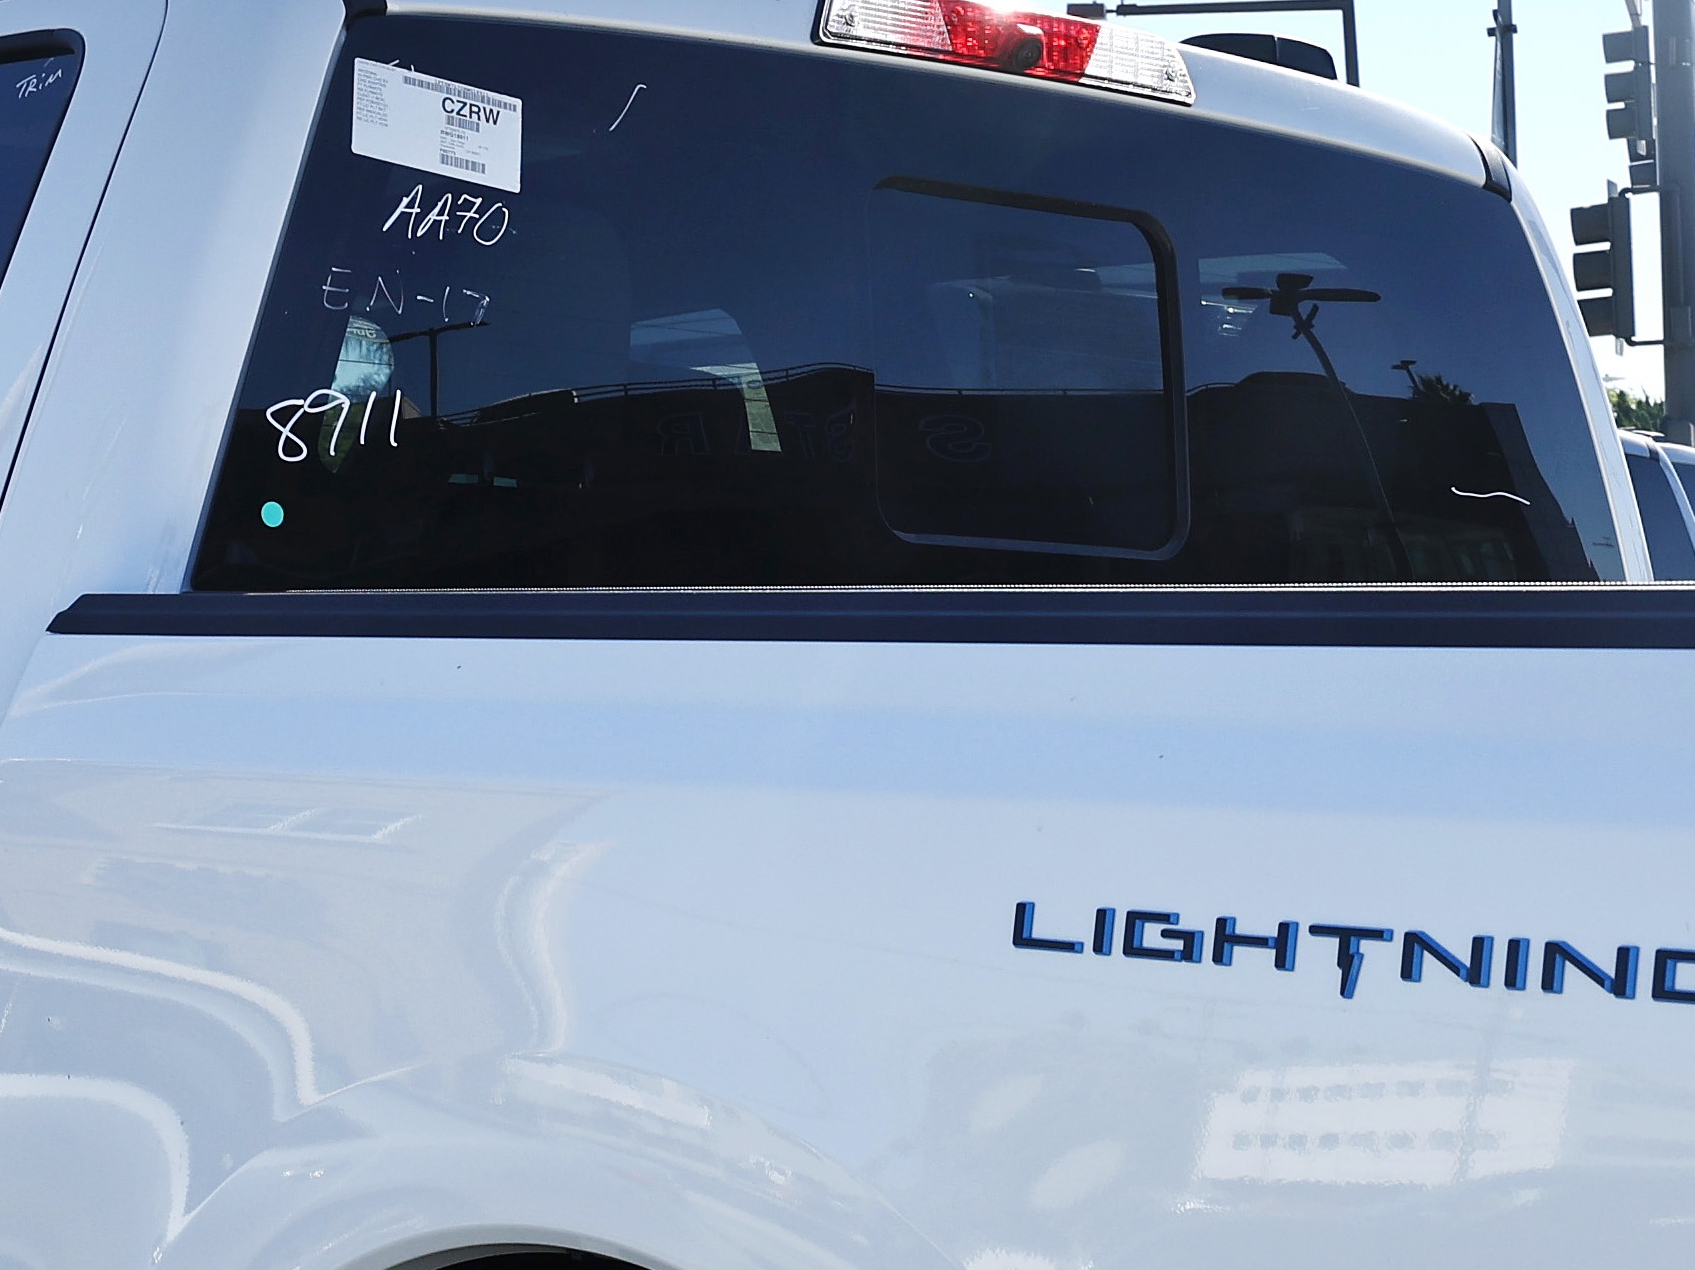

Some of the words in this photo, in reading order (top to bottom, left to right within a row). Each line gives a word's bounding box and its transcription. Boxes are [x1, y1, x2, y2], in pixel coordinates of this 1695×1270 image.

[441, 96, 501, 126] CZRW
[383, 184, 509, 246] AA70
[266, 389, 402, 461] 8911
